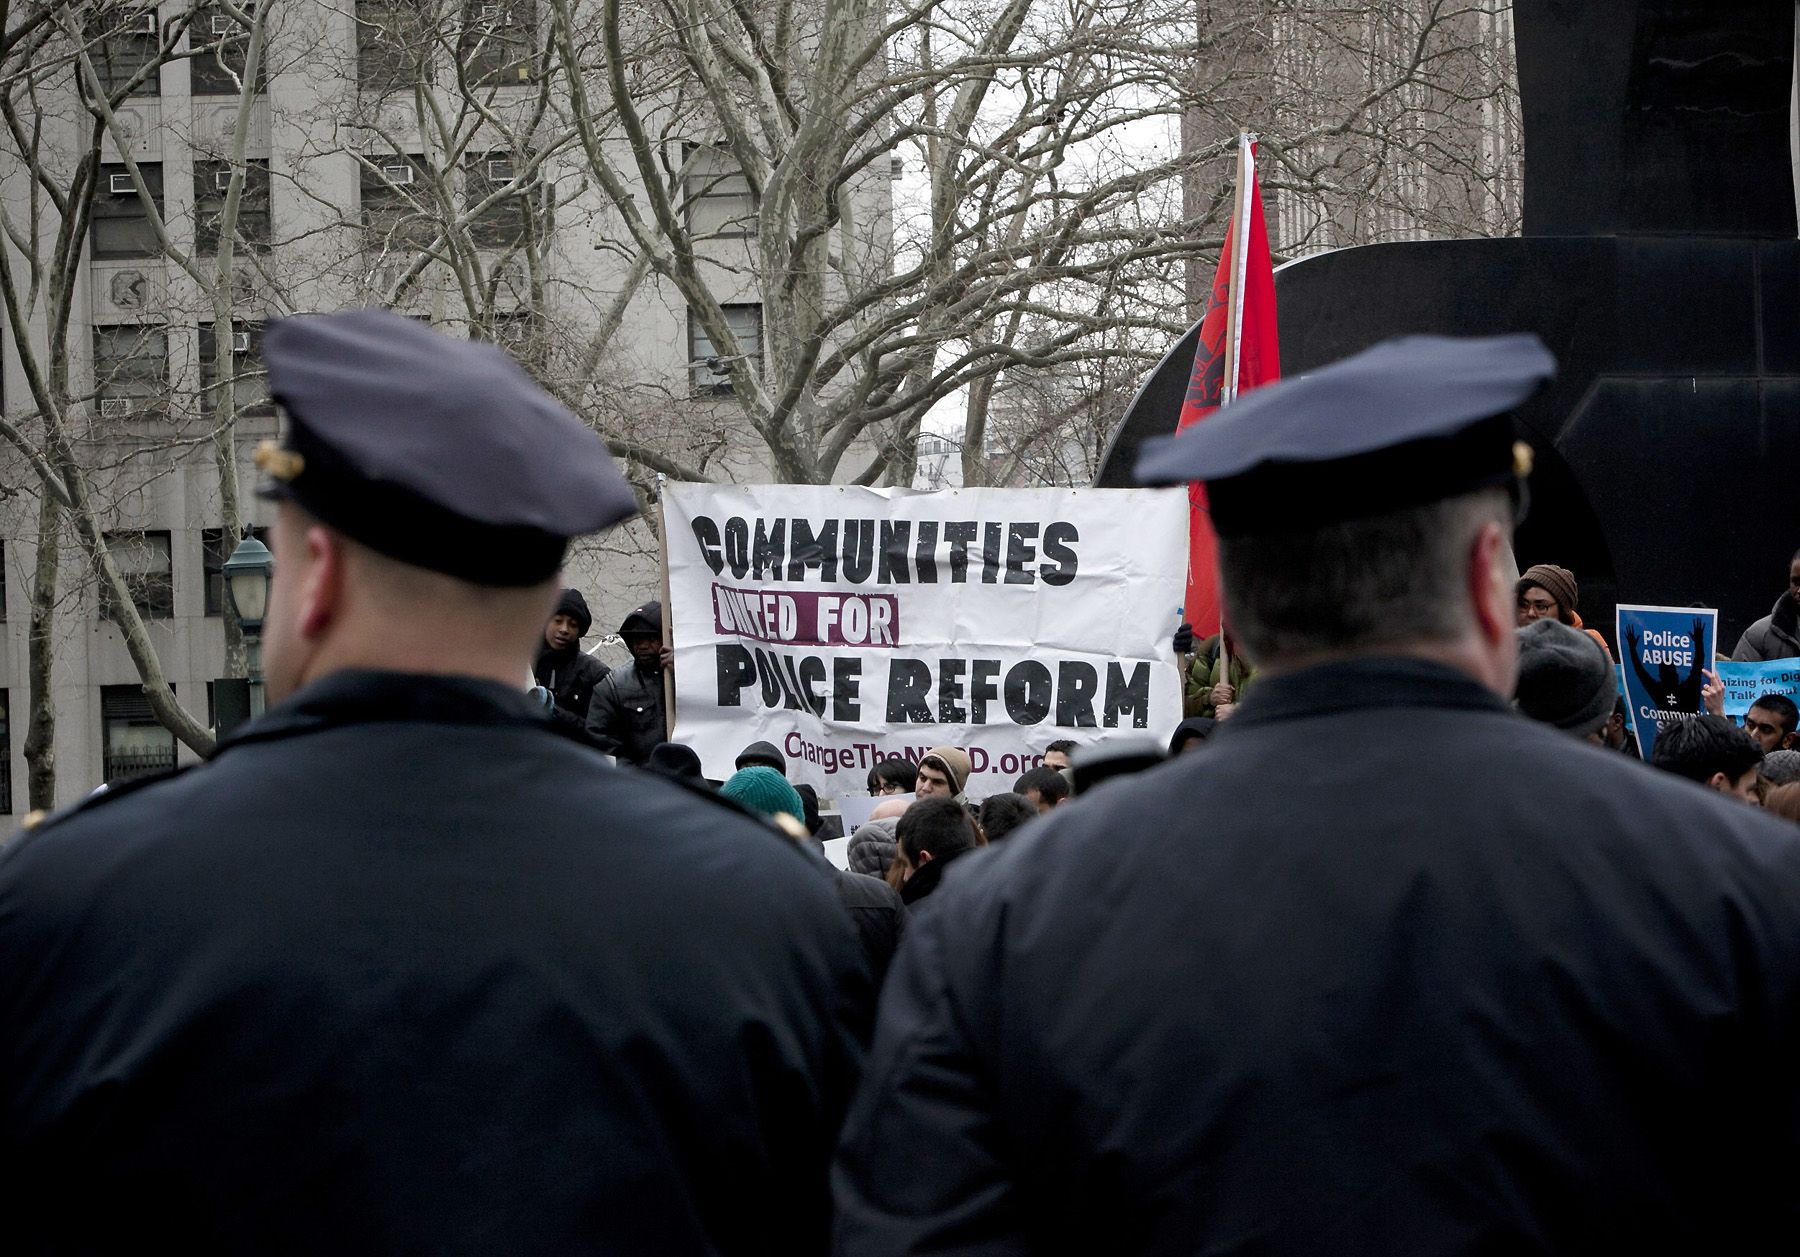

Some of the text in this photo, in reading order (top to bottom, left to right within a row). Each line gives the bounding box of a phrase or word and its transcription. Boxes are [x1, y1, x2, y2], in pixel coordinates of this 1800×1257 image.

[691, 515, 1079, 586] COMMUNITIES
[715, 587, 894, 645] UNITED FOR
[1643, 630, 1690, 648] Police
[1642, 649, 1692, 667] ABUSE
[716, 644, 1150, 729] POLICE REFORM
[1760, 676, 1777, 686] for
[1728, 690, 1757, 700] Talk
